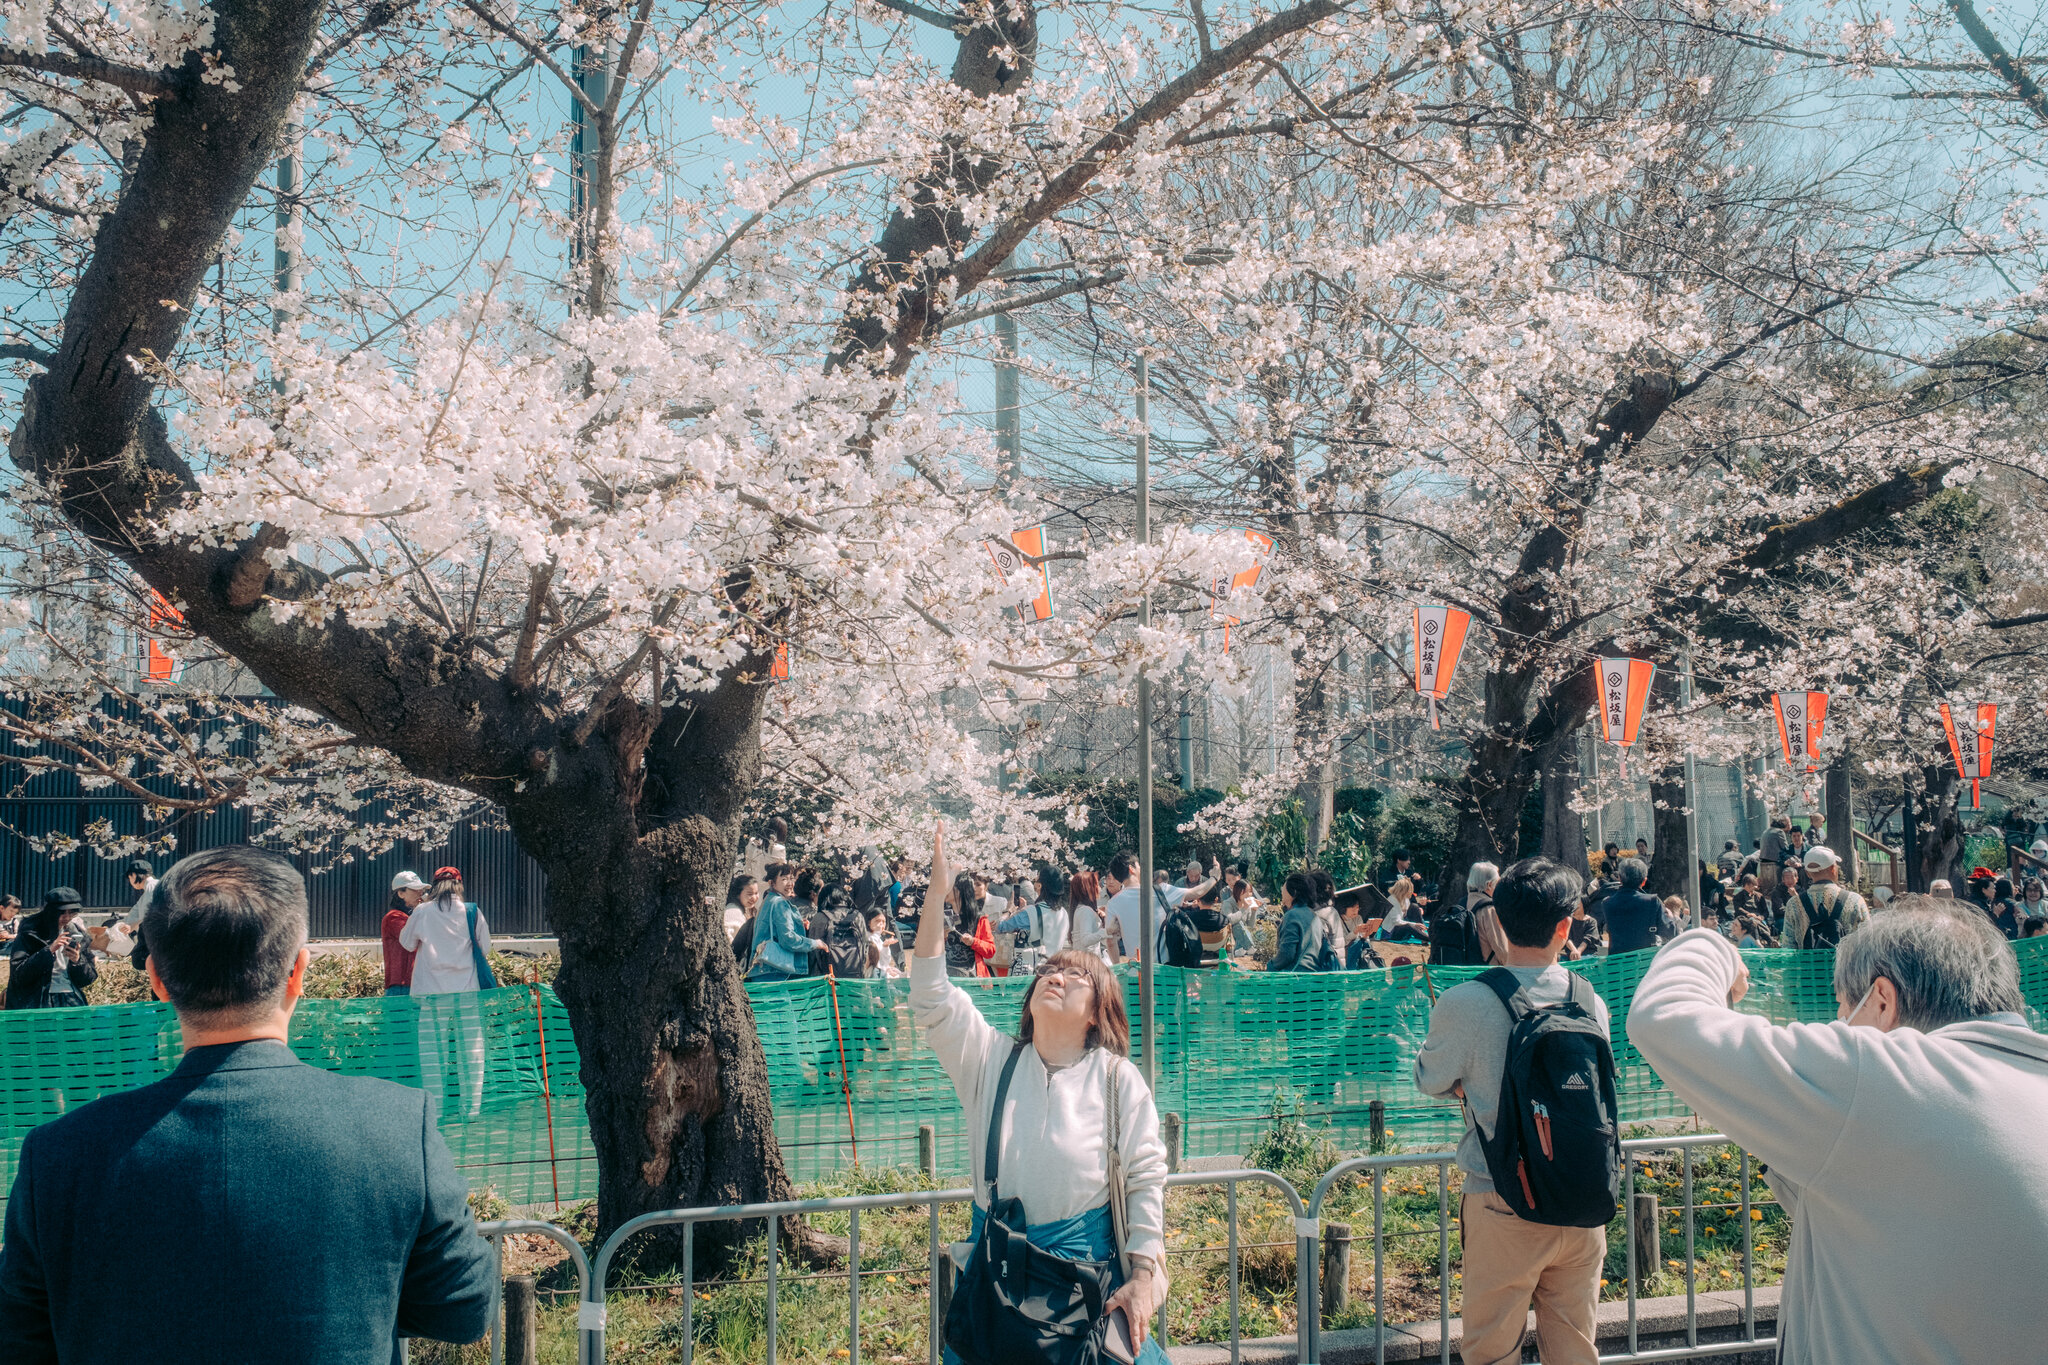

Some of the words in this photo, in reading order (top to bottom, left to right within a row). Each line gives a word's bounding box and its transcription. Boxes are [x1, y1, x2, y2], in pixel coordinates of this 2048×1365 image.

[1422, 636, 1436, 676] 松坂屋
[1609, 689, 1621, 726] 松坂屋
[1788, 721, 1803, 756] 松坂屋
